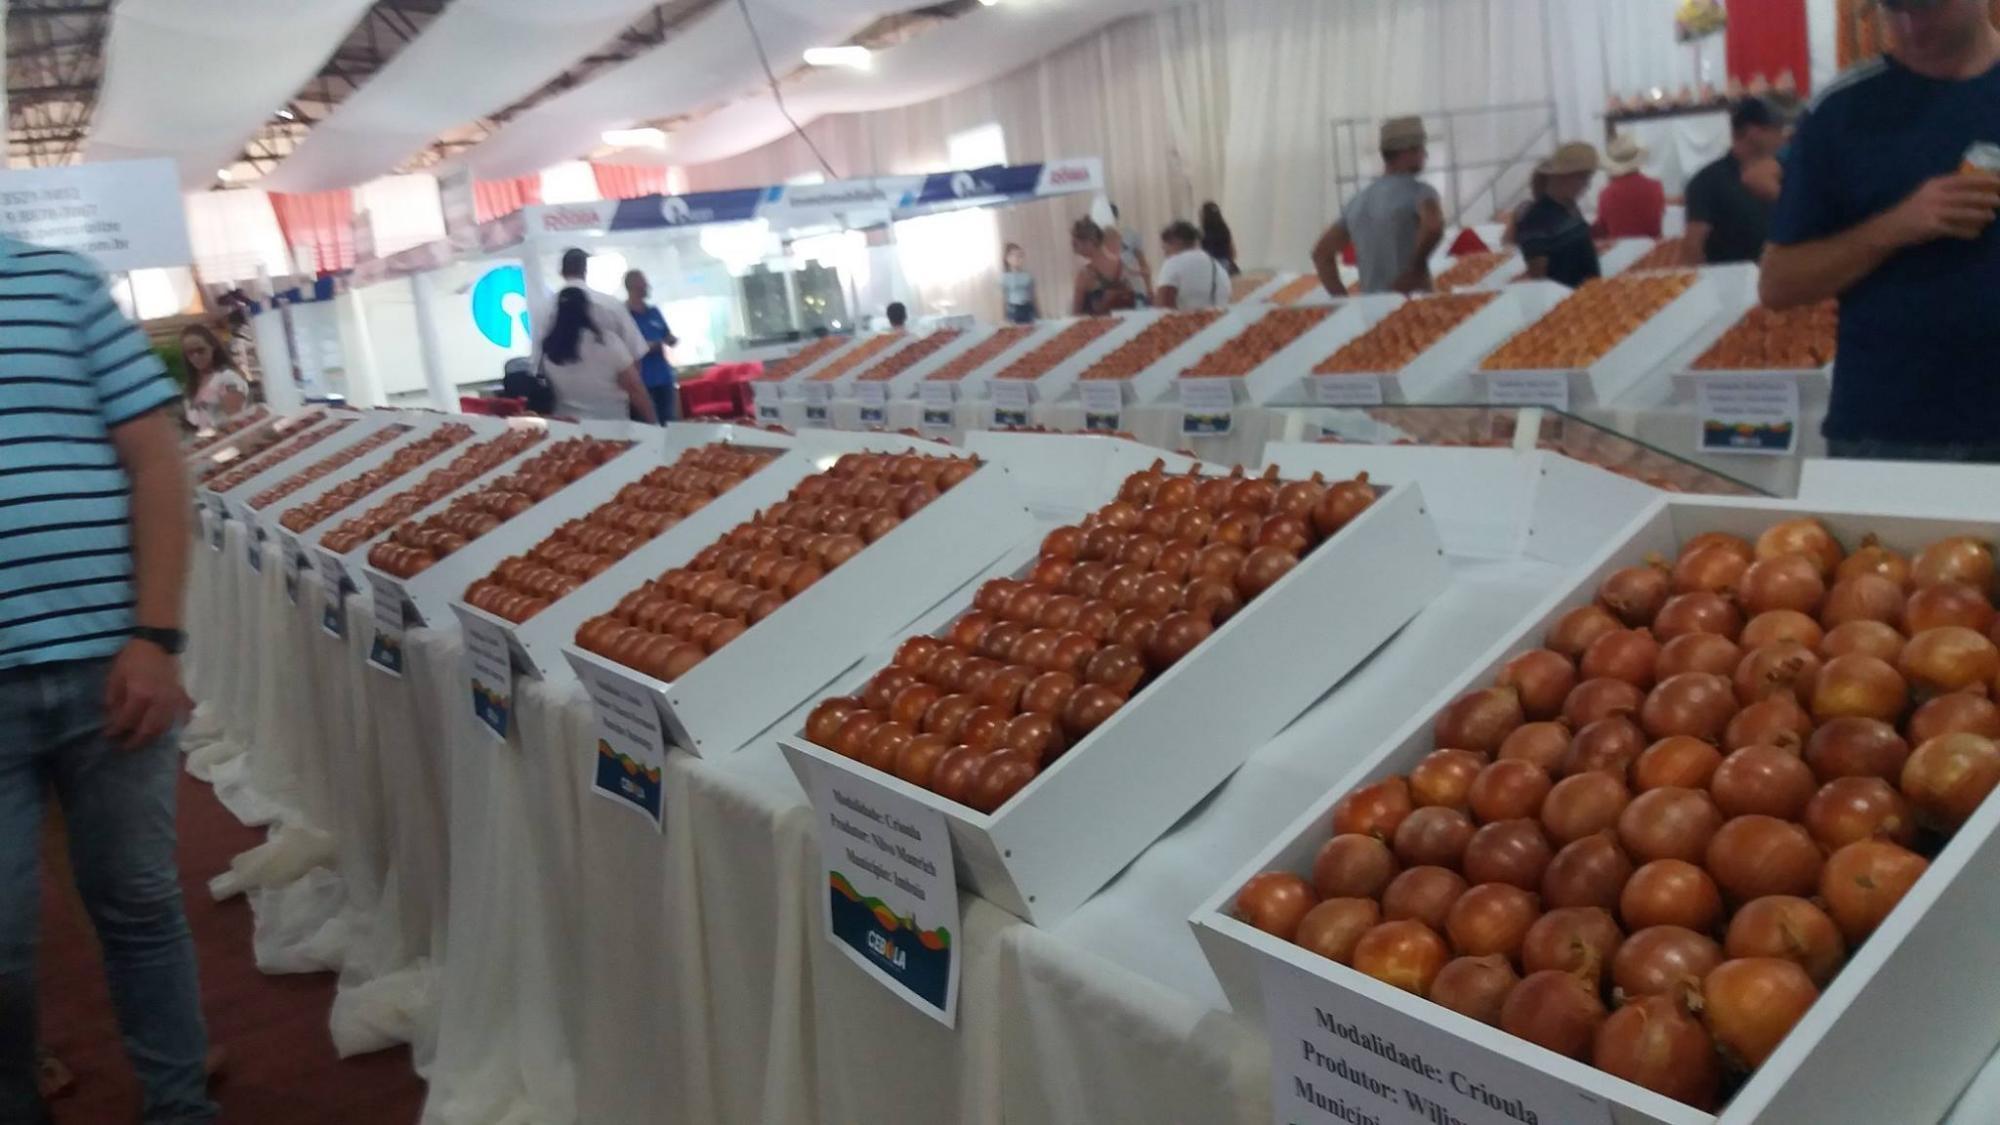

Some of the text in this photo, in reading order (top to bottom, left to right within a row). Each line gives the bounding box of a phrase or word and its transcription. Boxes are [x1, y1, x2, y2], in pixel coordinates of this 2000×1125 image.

[884, 814, 922, 841] Crioula
[1302, 1039, 1466, 1125] Produtor: Wili
[1314, 1006, 1538, 1125] Modalidade: Crioula
